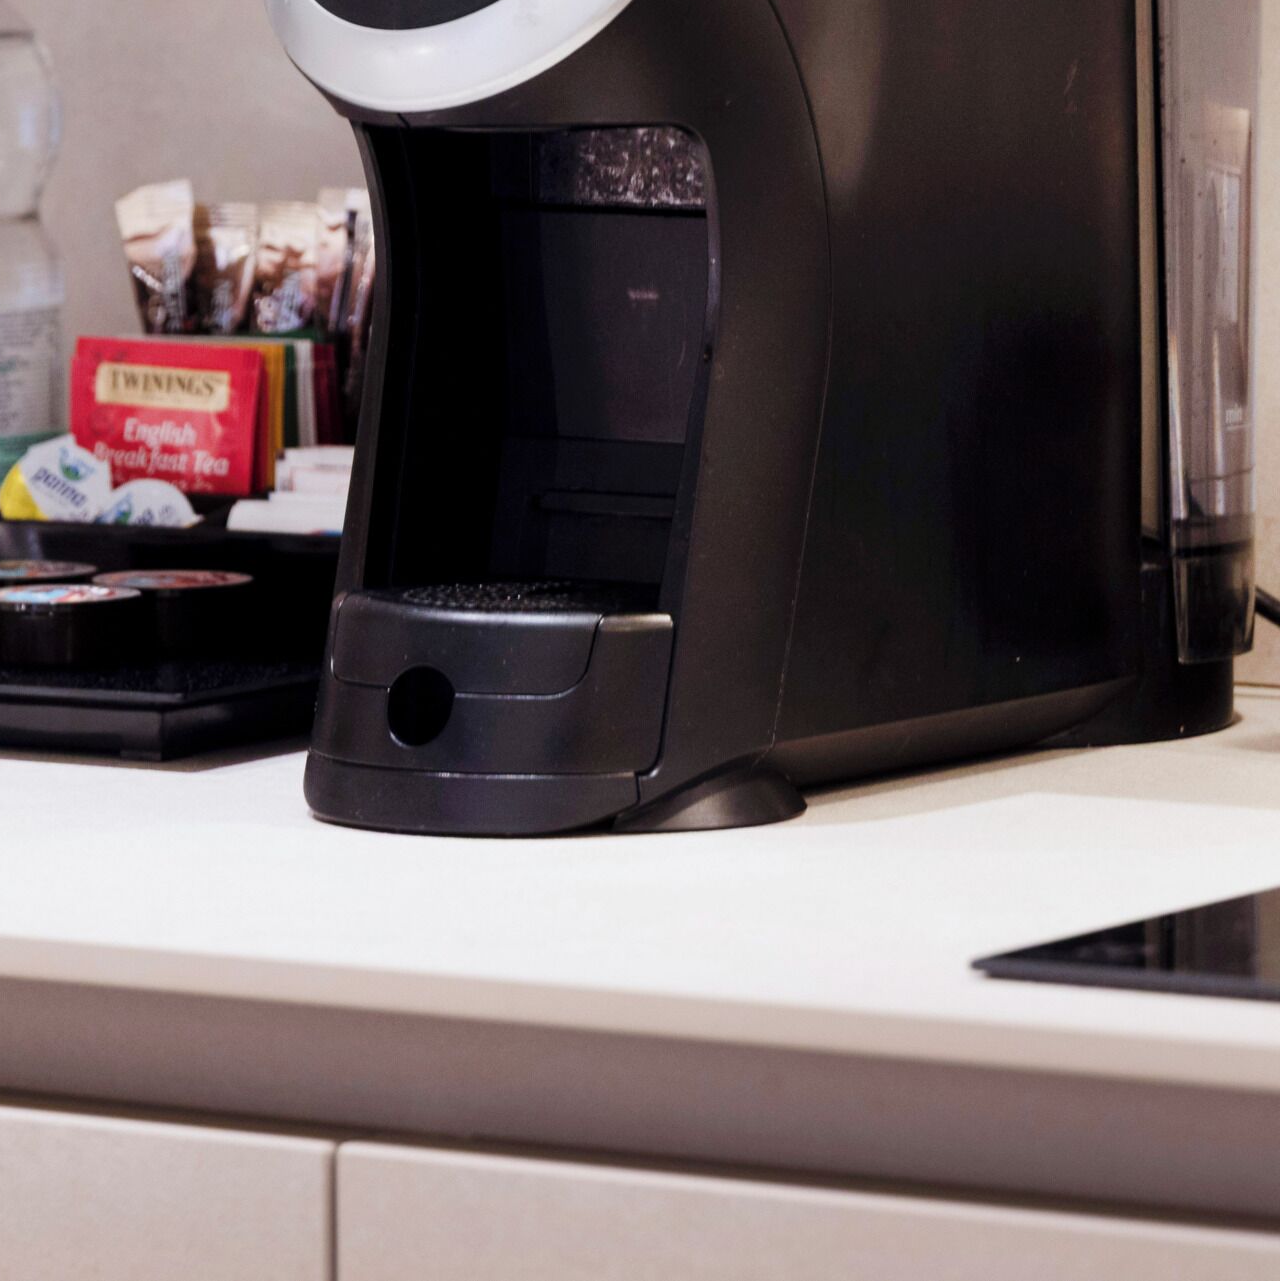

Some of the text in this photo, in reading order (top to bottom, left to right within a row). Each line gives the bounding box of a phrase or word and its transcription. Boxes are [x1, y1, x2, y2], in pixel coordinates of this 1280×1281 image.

[111, 369, 214, 396] TWININGS
[124, 417, 197, 449] English
[193, 450, 230, 477] Tea
